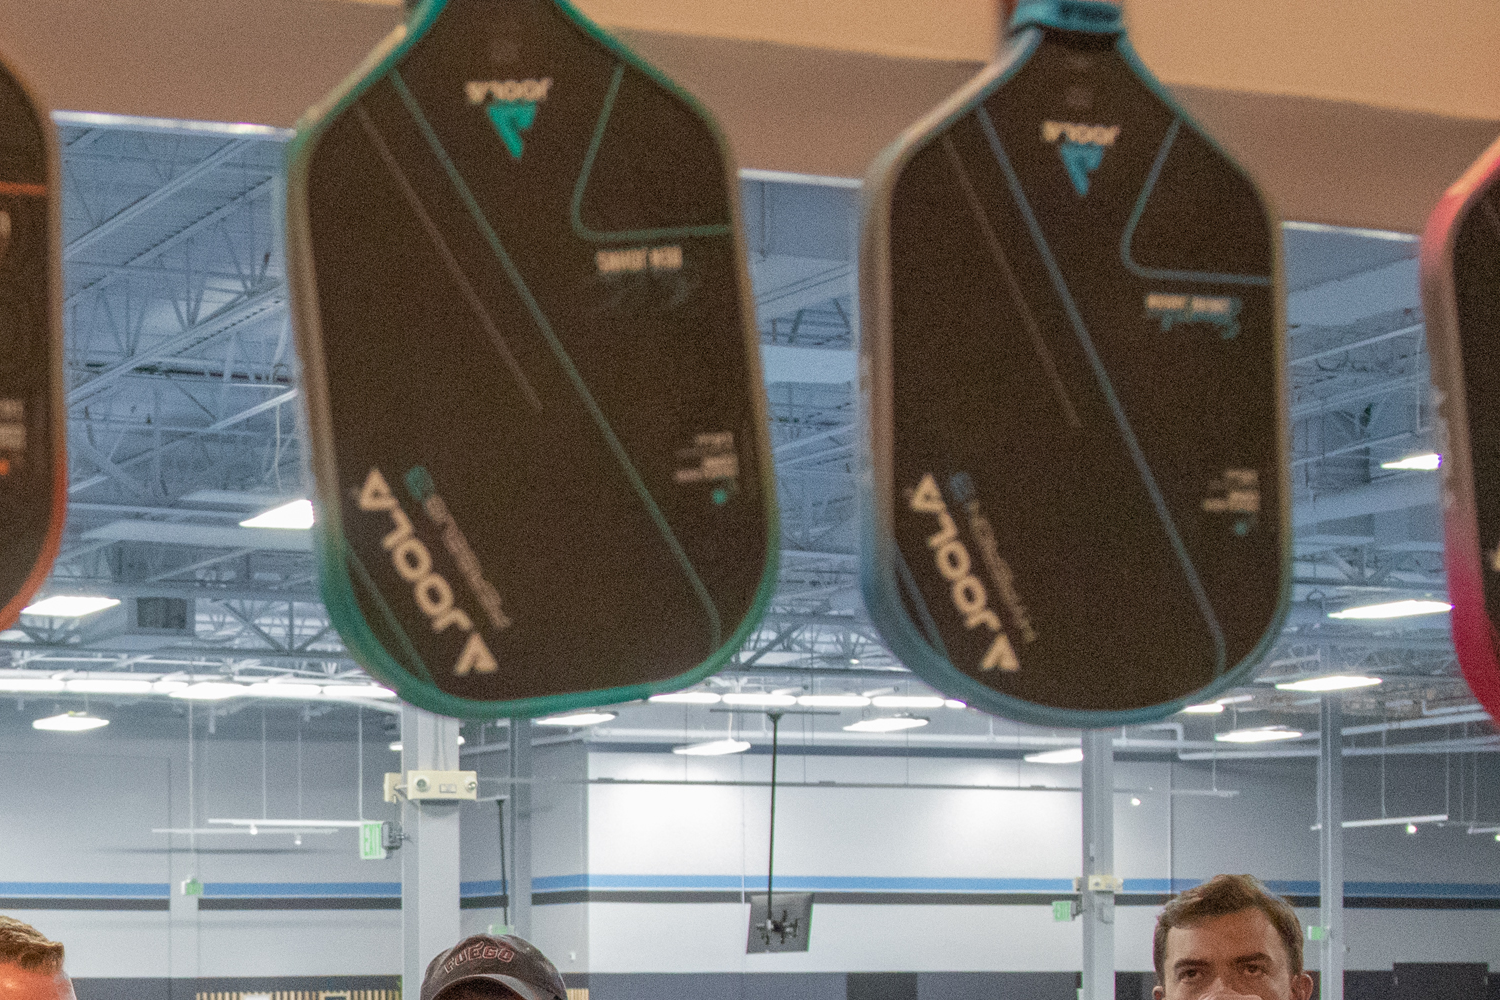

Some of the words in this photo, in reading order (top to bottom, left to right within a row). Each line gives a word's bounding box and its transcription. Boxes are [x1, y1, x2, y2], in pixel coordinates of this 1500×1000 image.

[465, 78, 553, 104] JOOLA
[1042, 121, 1120, 146] JOOLA
[353, 469, 473, 632] JOOLA
[910, 475, 1001, 631] JOOLA
